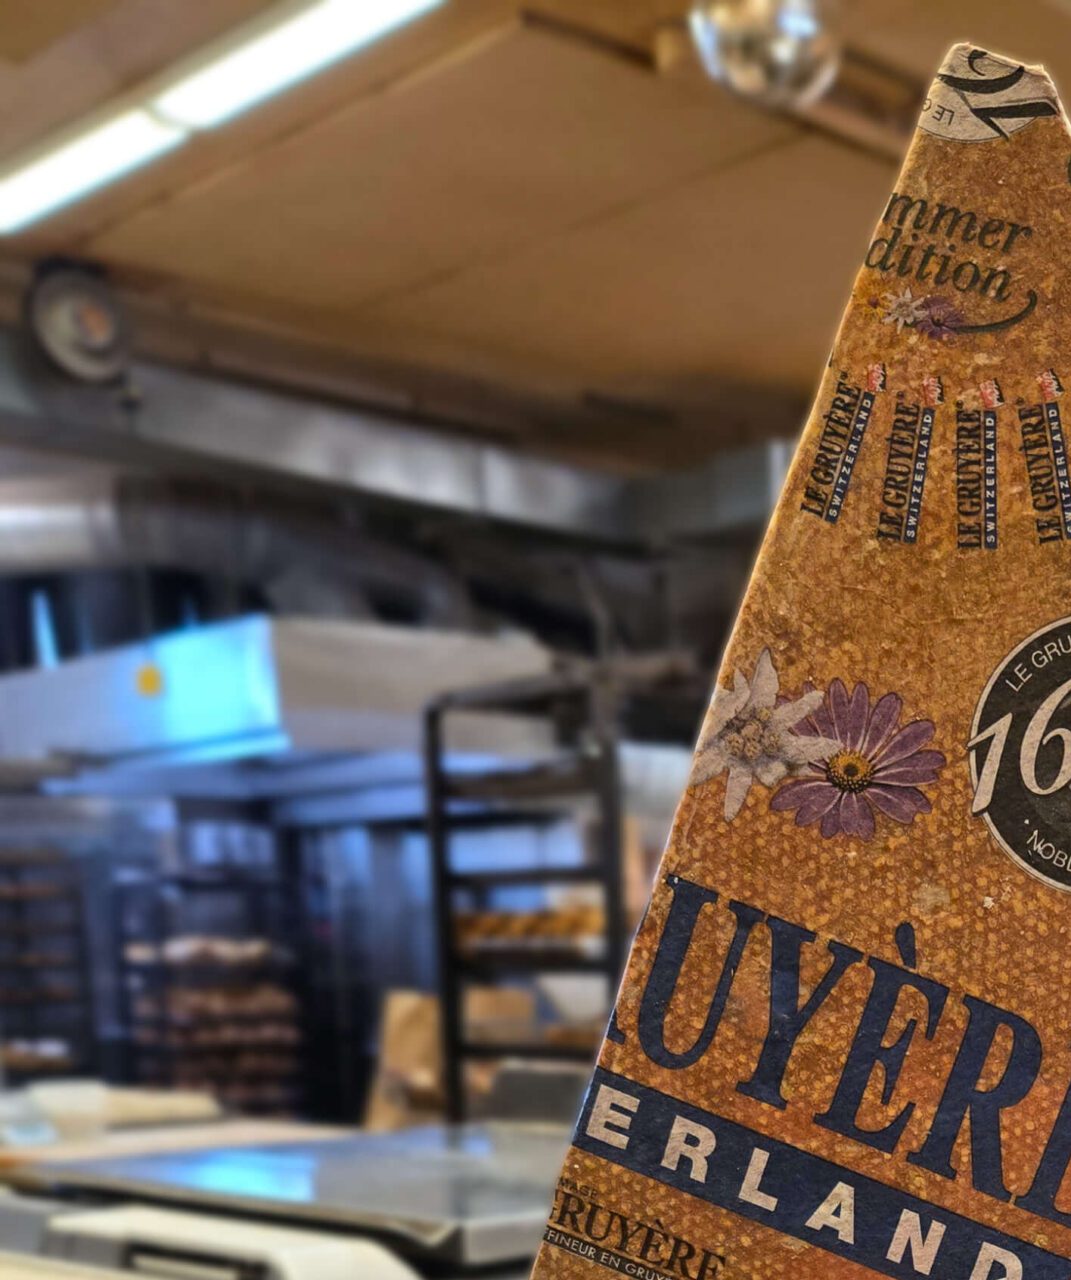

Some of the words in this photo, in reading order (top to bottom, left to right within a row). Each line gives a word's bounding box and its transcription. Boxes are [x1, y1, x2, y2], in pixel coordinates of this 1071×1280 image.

[829, 399, 873, 517] SWITZERLAND
[906, 413, 933, 539] SWITZERLAND
[985, 416, 996, 543] SWITZERLAND
[801, 486, 829, 518] LE
[876, 511, 904, 541] LE
[957, 521, 983, 549] LE
[1036, 515, 1064, 545] LE
[1004, 664, 1034, 693] LE
[600, 1251, 621, 1269] EN
